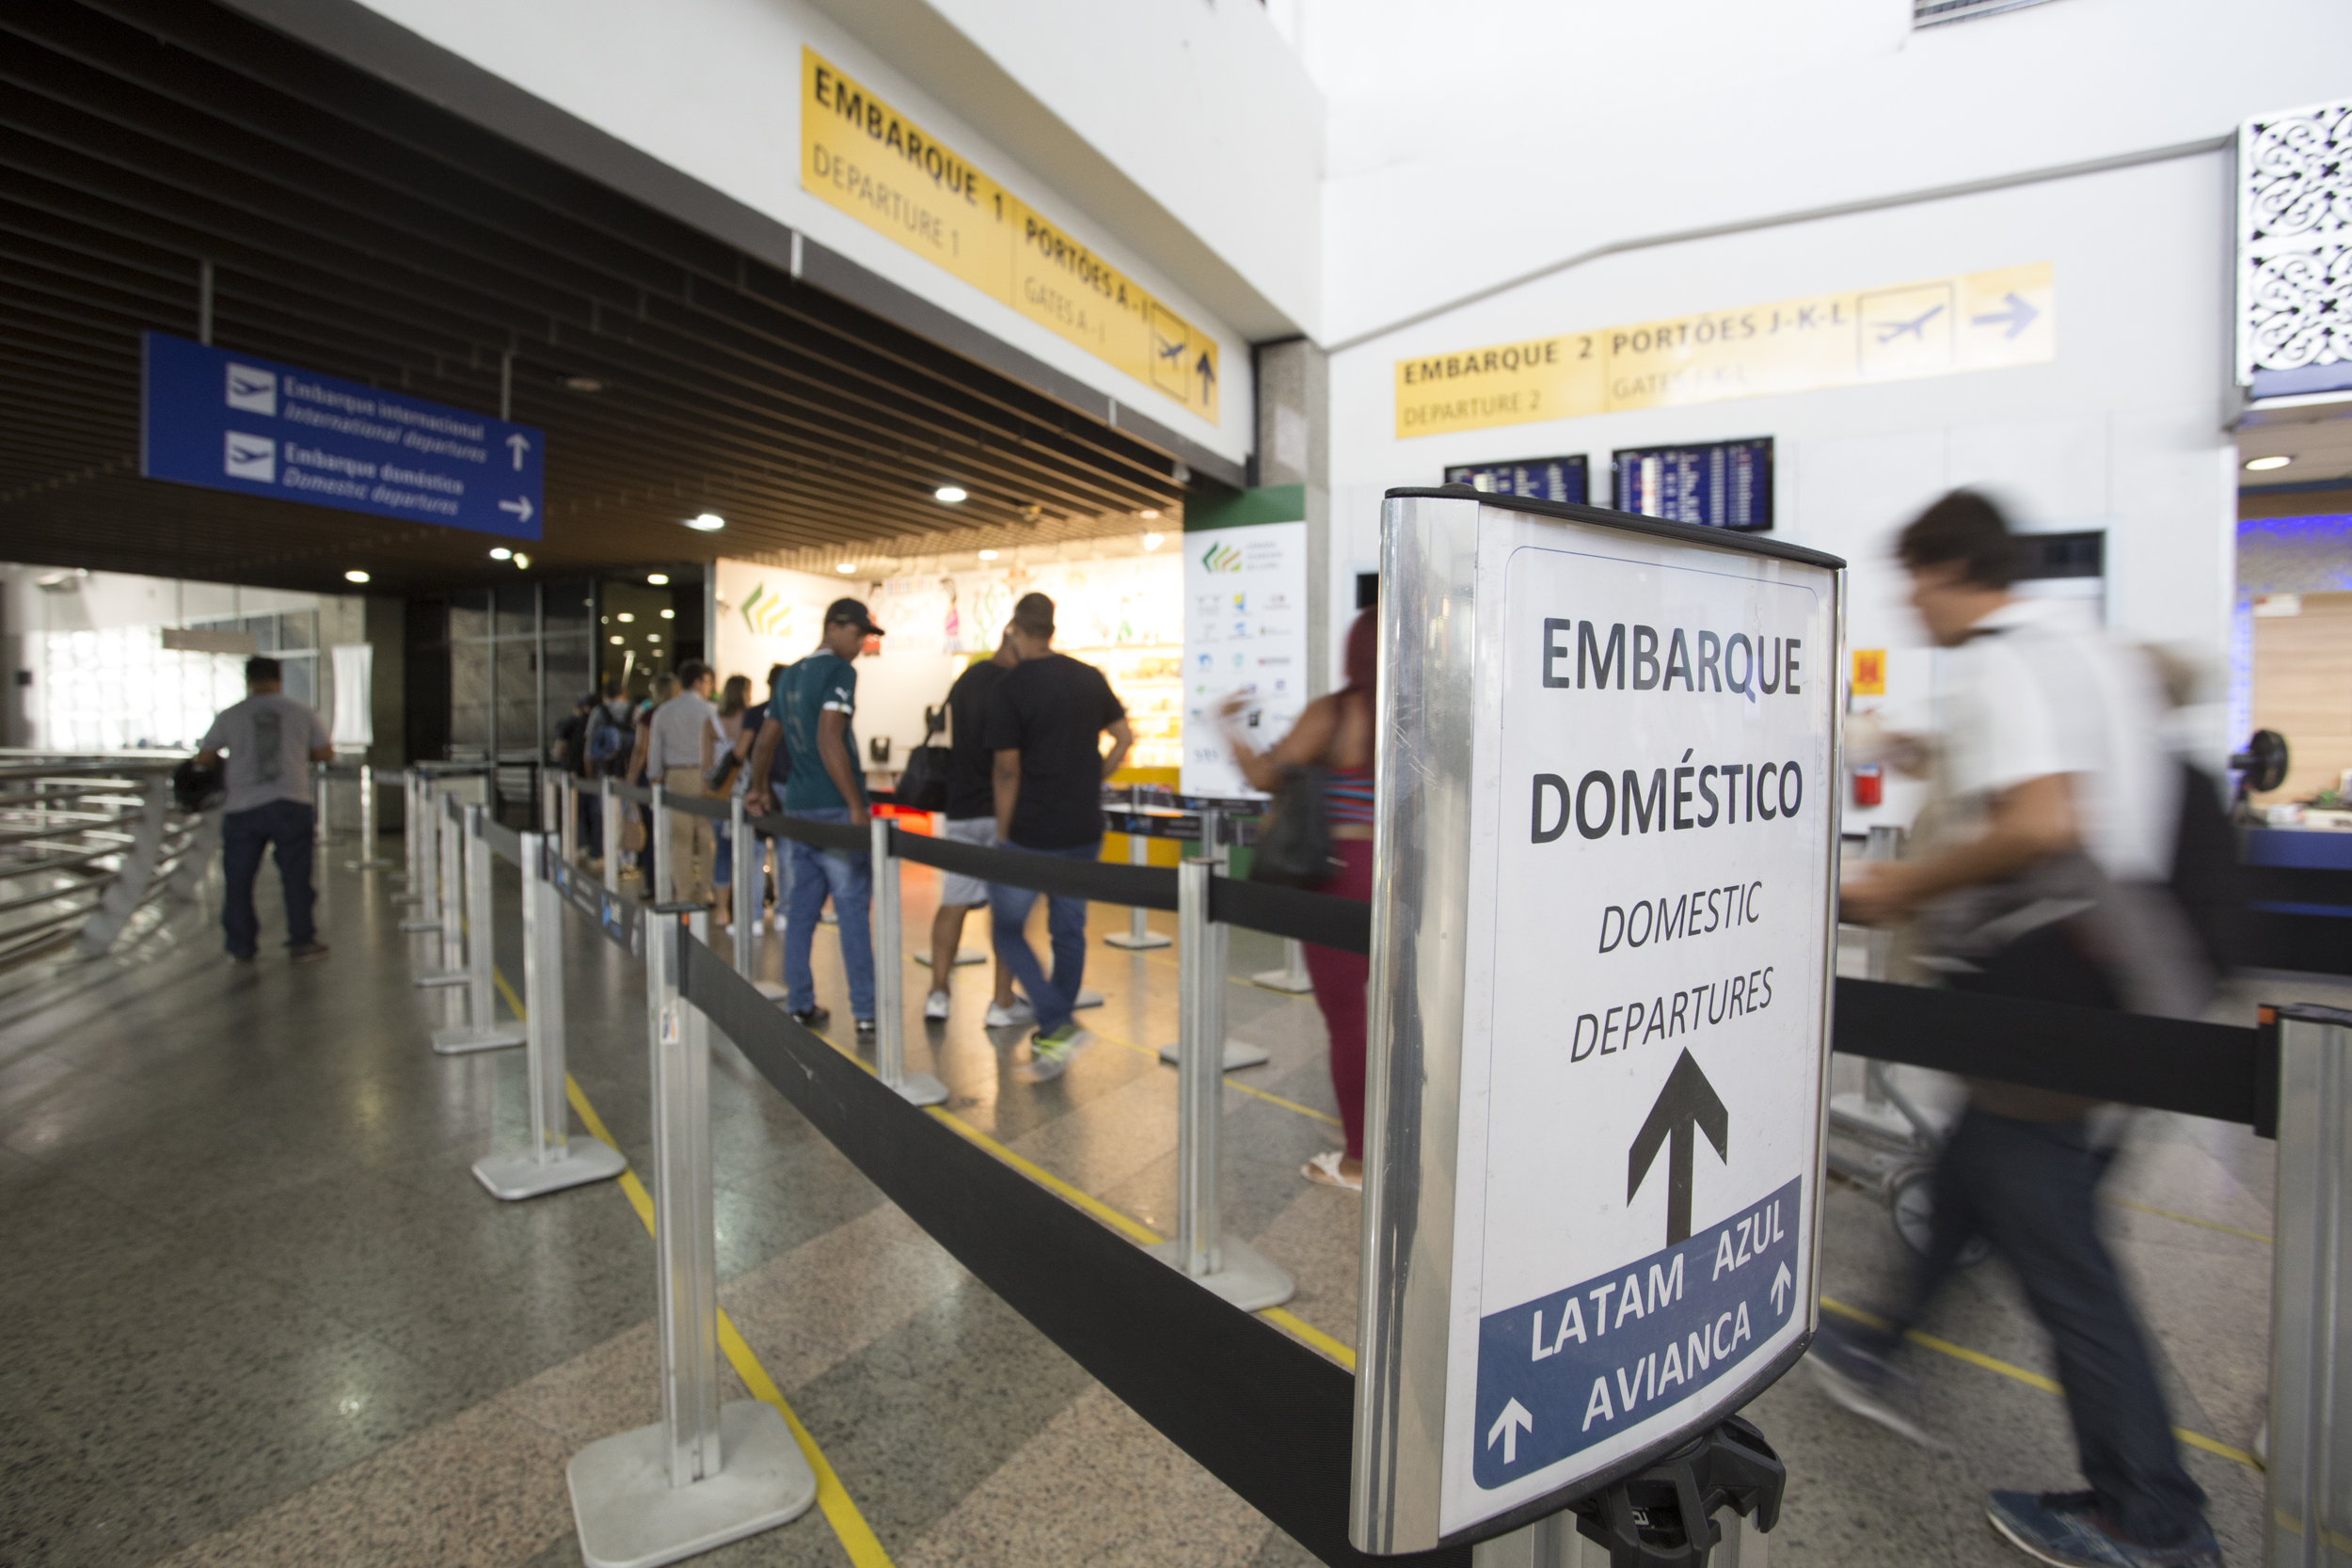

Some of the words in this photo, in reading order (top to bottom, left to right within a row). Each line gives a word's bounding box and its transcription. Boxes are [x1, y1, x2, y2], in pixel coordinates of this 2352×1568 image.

[815, 65, 977, 206] EMBARQUE
[993, 192, 1004, 223] 1
[813, 143, 944, 249] DEPARTURE
[951, 230, 960, 257] 1
[1025, 216, 1113, 298] PORTÕES
[1024, 277, 1074, 325] GATES
[1612, 312, 1756, 356] PORTÕES
[1404, 340, 1560, 386] EMBARQUE
[1578, 336, 1593, 359] 2
[283, 376, 376, 416] Embarque
[377, 398, 485, 441] internacional
[283, 401, 403, 444] International
[403, 429, 487, 464] departures
[1403, 390, 1521, 428] DEPARTURE
[1529, 388, 1542, 410] 2
[283, 441, 376, 478] Embarque
[283, 467, 370, 500] Domestic
[371, 483, 459, 516] departures
[1542, 617, 1802, 704] EMBARQUE
[1530, 748, 1803, 845] DOMÉSTICO
[1598, 881, 1763, 955] DOMESTIC
[1570, 966, 1774, 1063] DEPARTURES
[1531, 1252, 1684, 1362] LATAM
[1711, 1198, 1785, 1283] AZUL
[1581, 1300, 1752, 1433] AVIANCA
